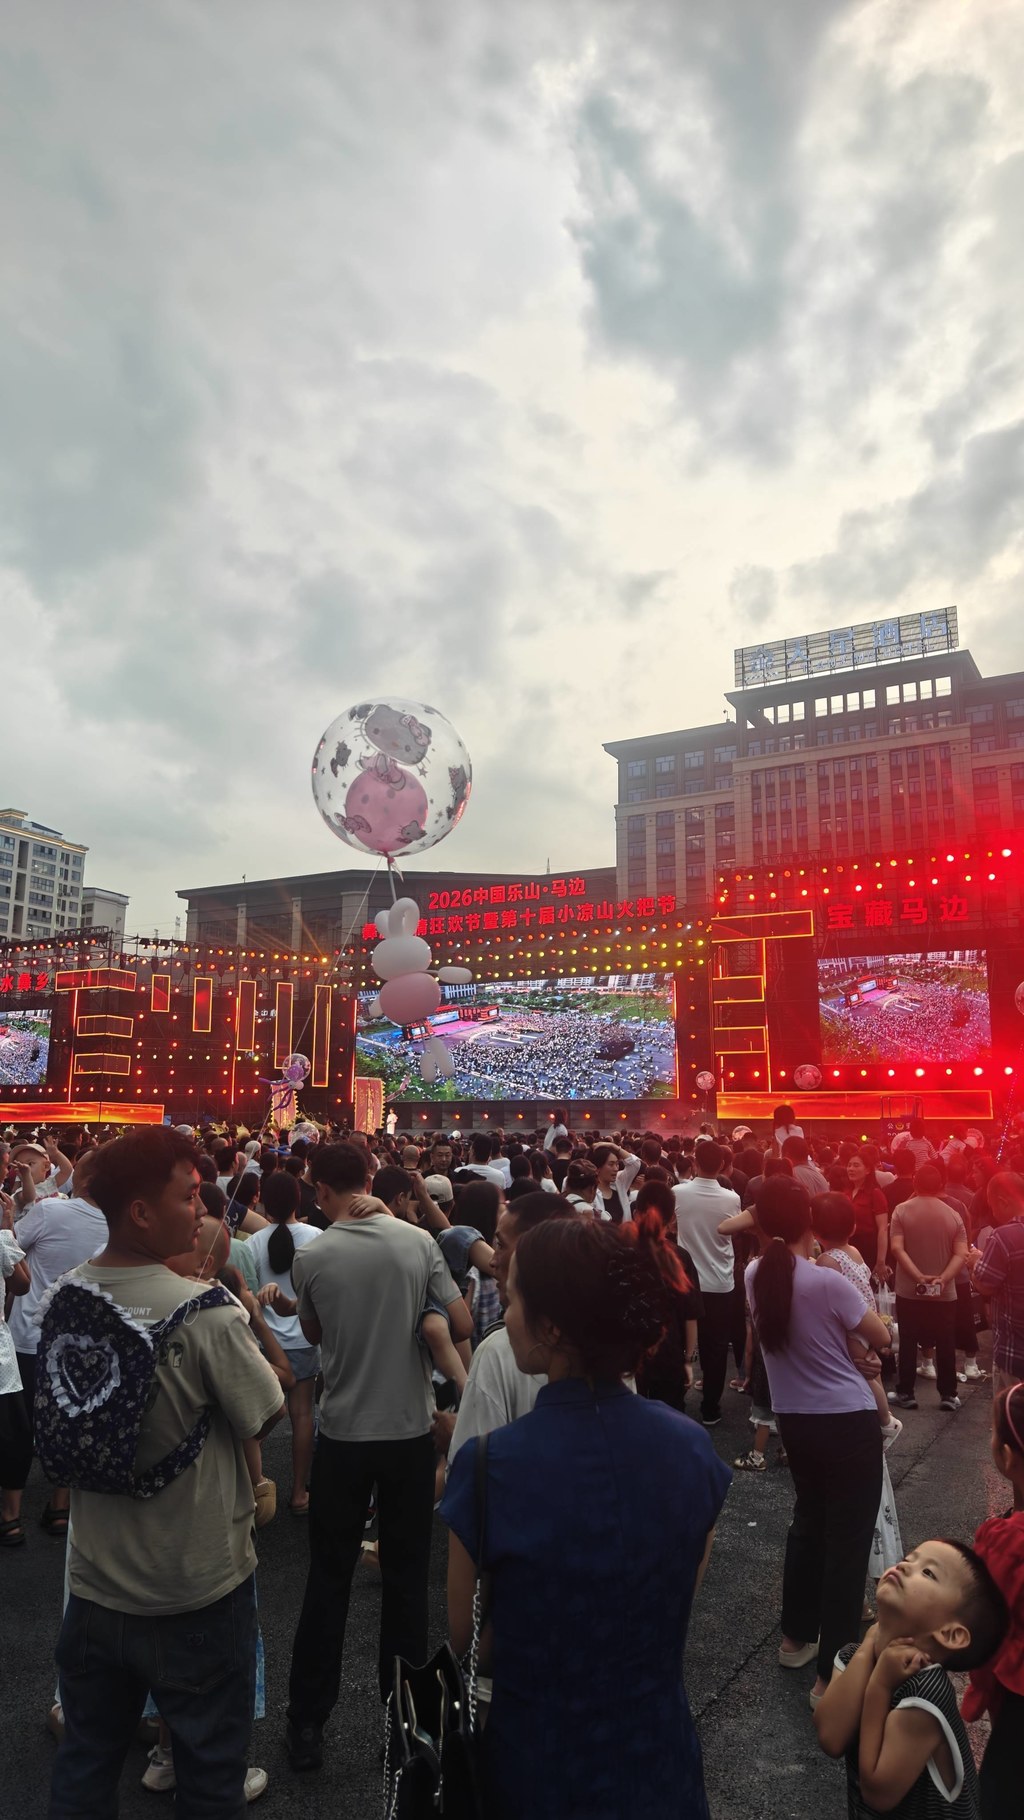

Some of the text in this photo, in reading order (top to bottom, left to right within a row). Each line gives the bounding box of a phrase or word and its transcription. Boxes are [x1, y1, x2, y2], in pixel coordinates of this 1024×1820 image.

[428, 876, 586, 911] 2026中国乐山·马边
[362, 895, 676, 940] 彝情狂欢节暨第十届小凉山火把节
[827, 894, 970, 929] 宝藏马边
